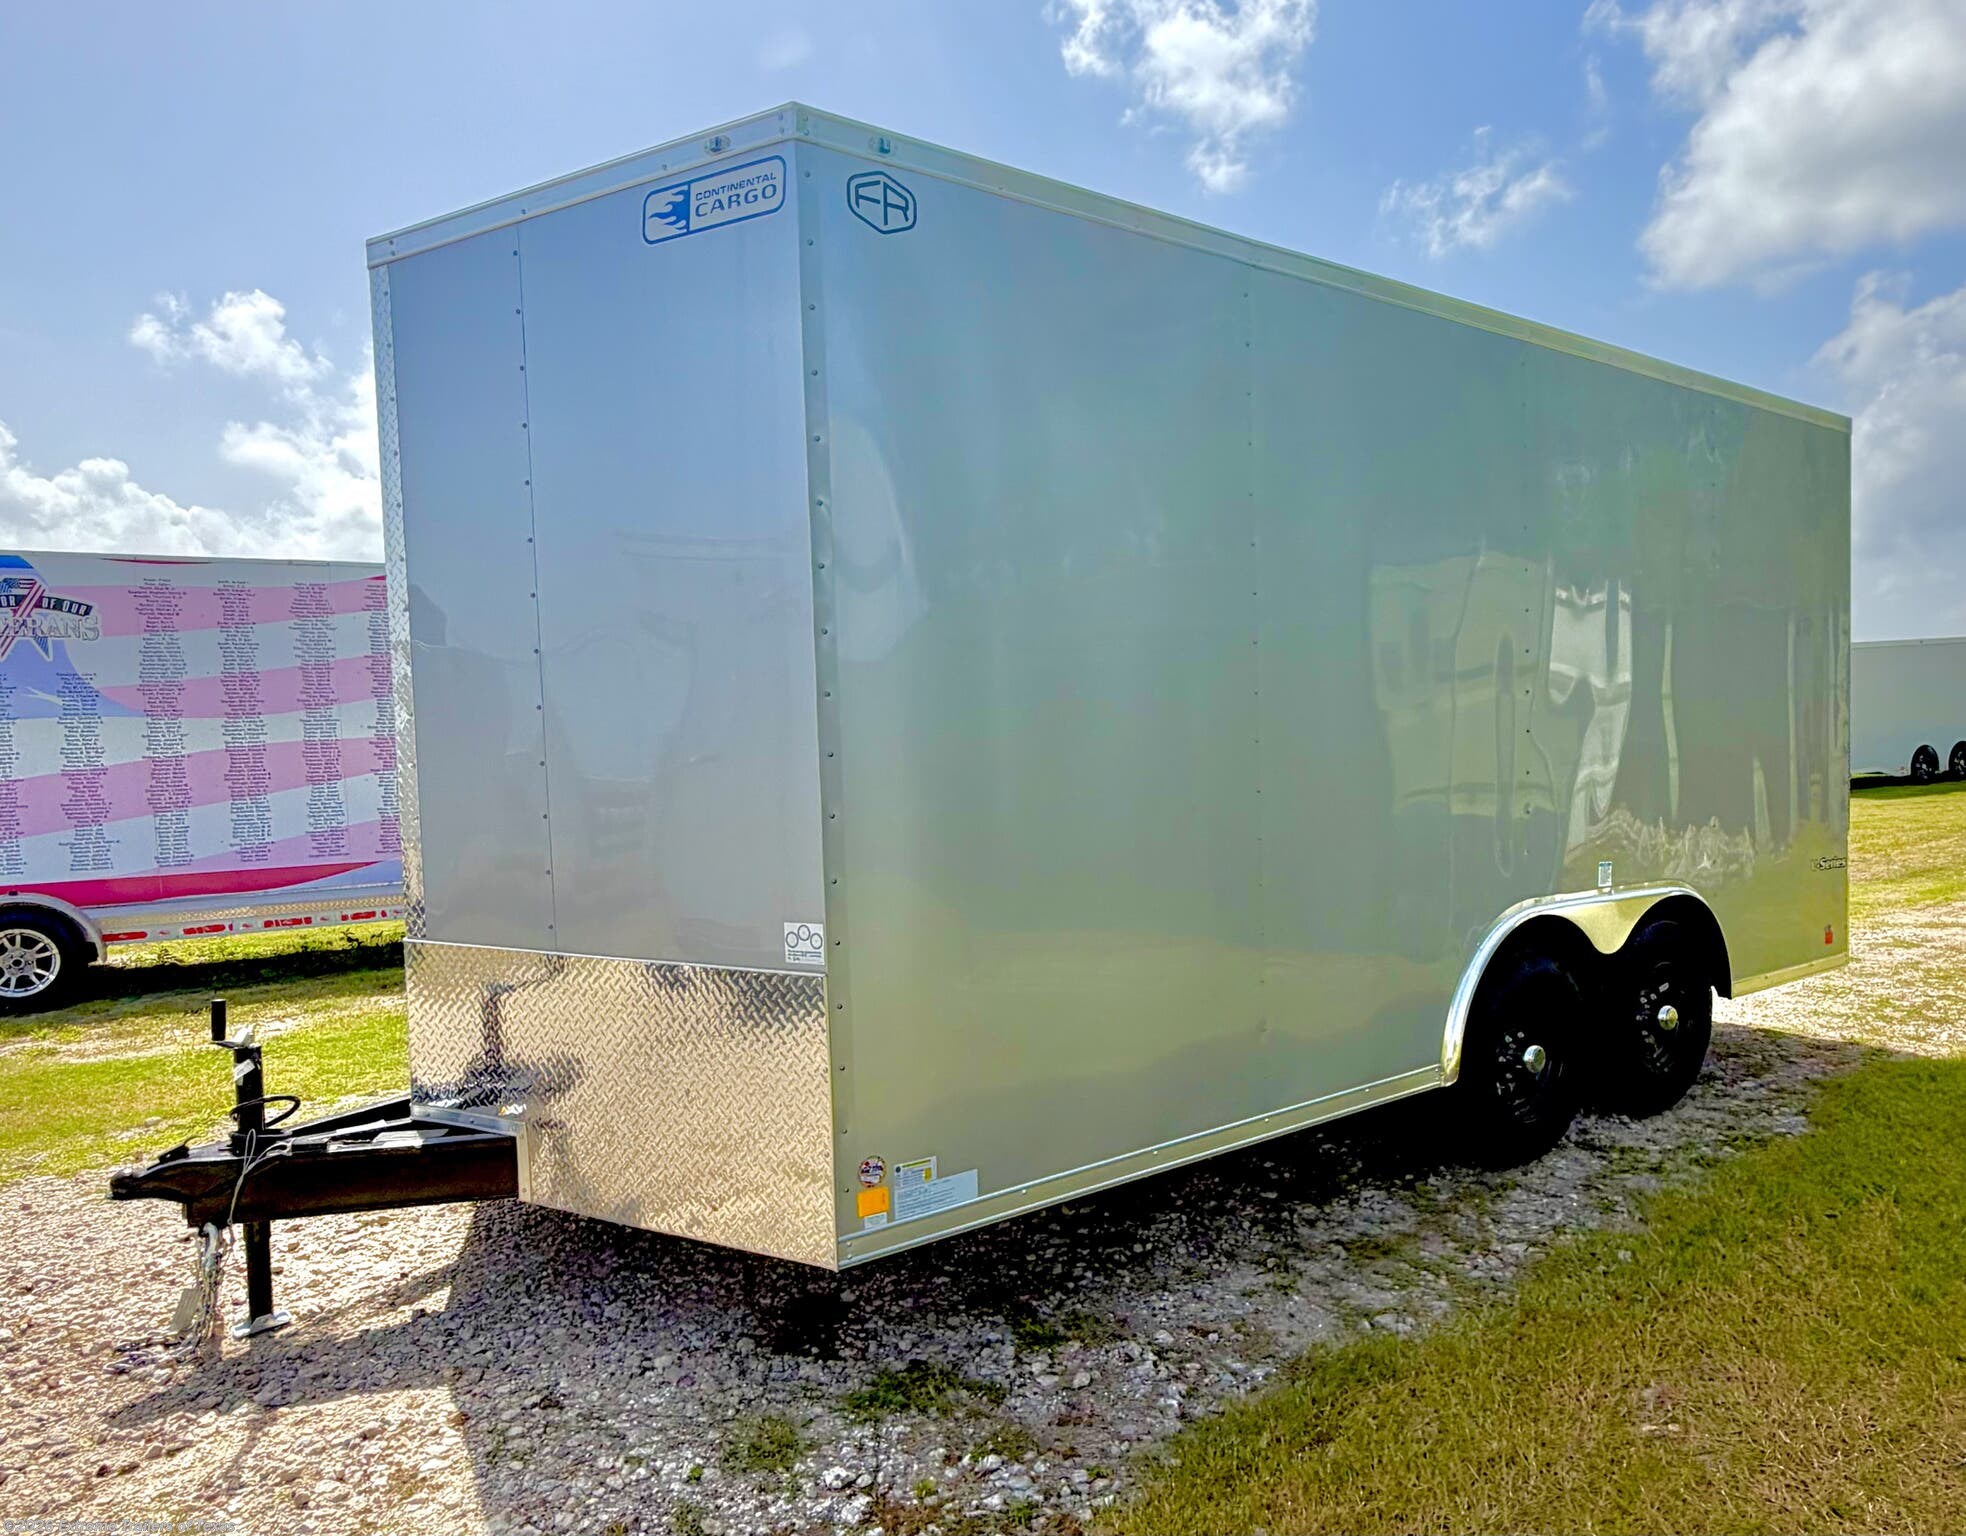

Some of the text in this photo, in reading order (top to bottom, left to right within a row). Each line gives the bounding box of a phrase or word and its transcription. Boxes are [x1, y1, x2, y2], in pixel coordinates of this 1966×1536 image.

[695, 172, 777, 200] CONTINENTAL
[695, 183, 777, 218] CARGO
[42, 597, 57, 609] OF
[62, 600, 87, 615] OUR
